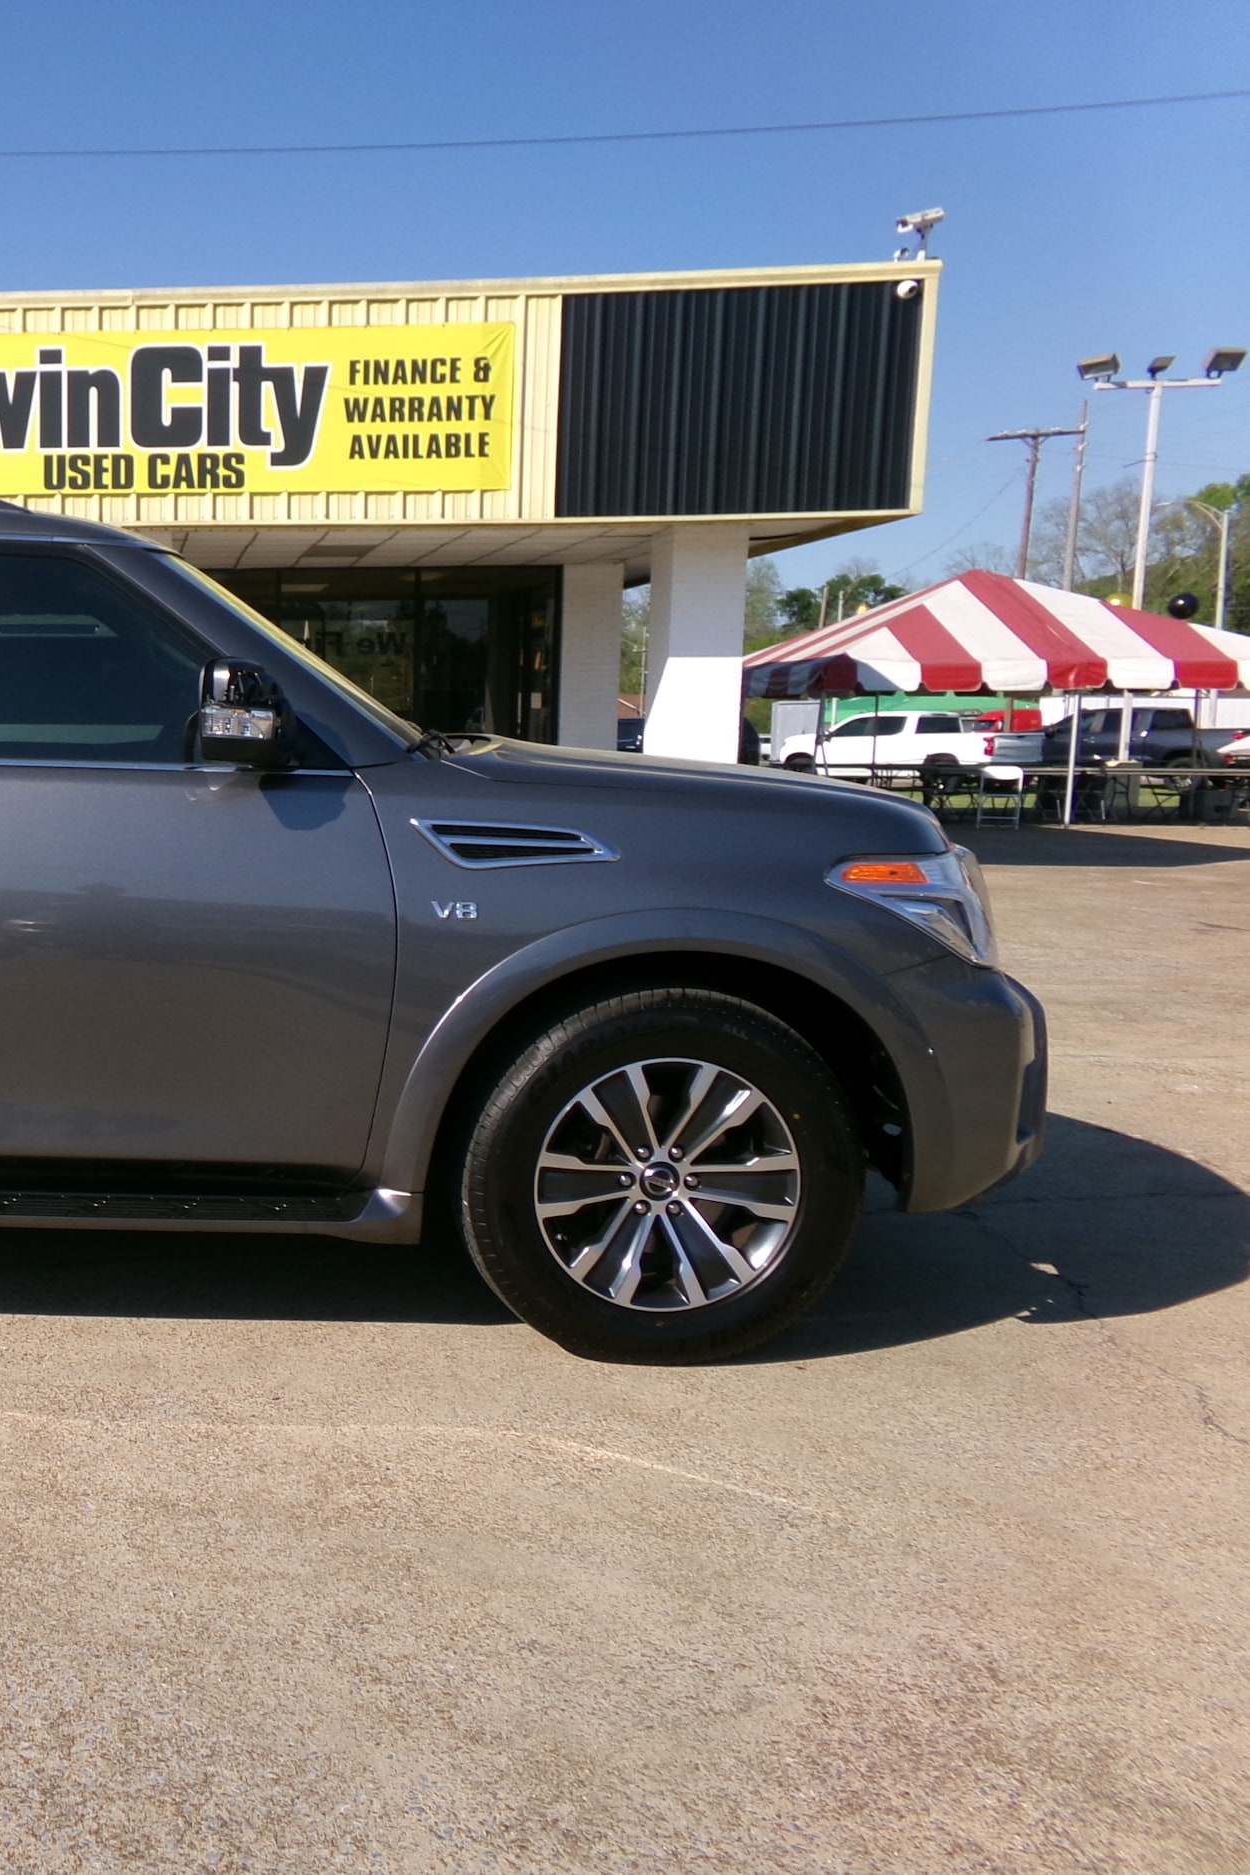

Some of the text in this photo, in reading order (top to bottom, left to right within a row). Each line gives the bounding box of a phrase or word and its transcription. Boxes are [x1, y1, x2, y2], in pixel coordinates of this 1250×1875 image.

[348, 357, 492, 386] FINANCE &
[343, 394, 496, 423] WARRANTY
[348, 432, 490, 460] AVAILABLE
[44, 452, 246, 490] USED CARS
[431, 900, 479, 920] V8
